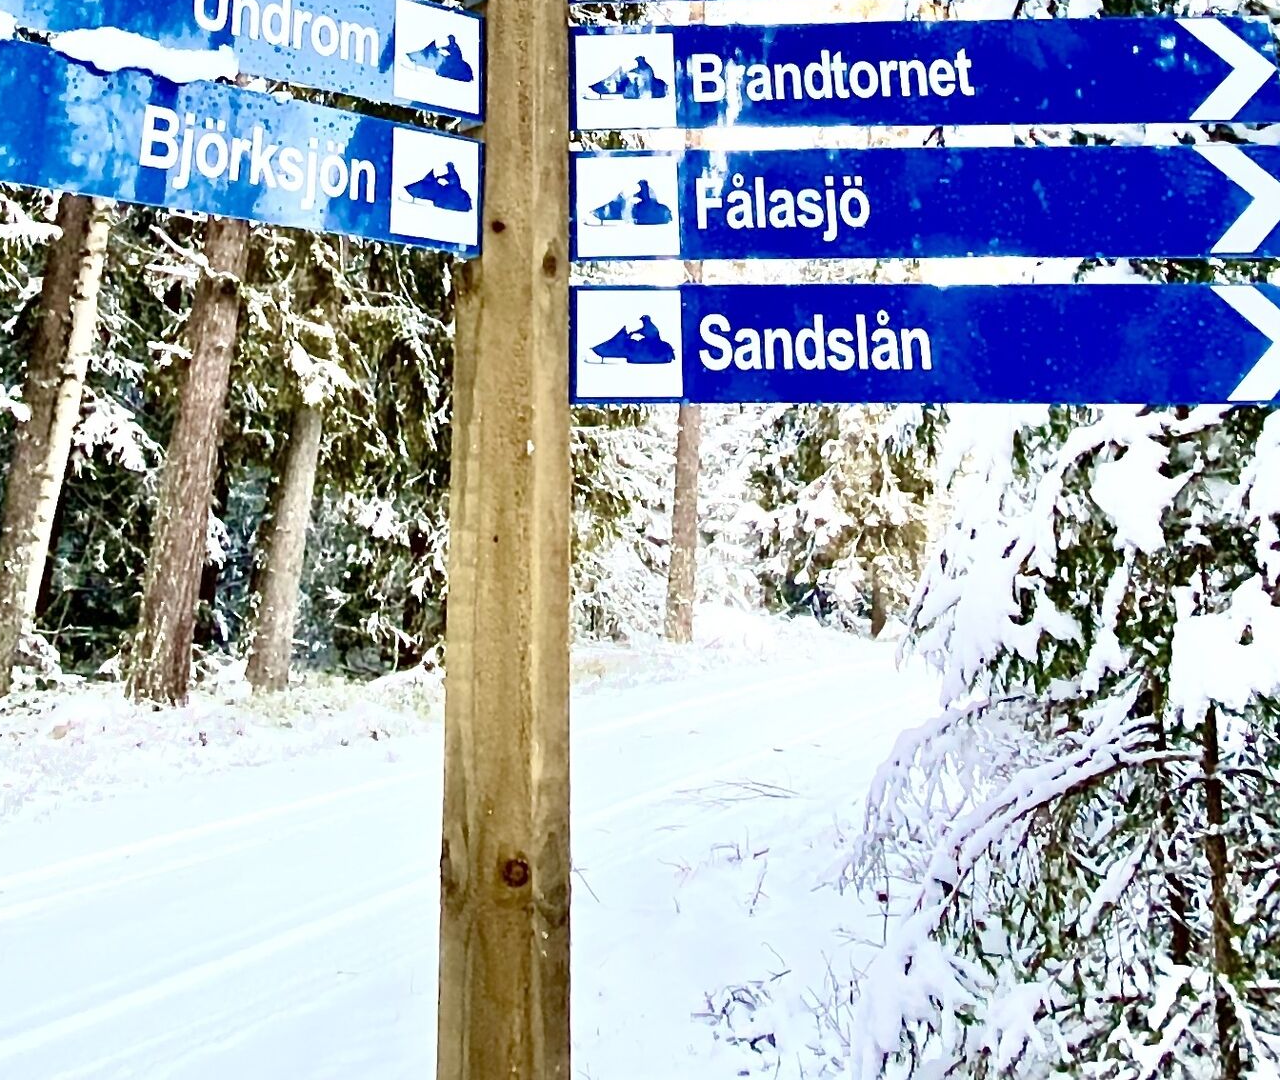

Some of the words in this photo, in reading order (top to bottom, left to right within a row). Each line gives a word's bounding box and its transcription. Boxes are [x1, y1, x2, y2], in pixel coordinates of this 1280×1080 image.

[690, 47, 975, 103] Brandtornet
[138, 104, 377, 210] Björksjön
[696, 173, 871, 242] Fålasjö
[698, 311, 933, 371] Sandslån
